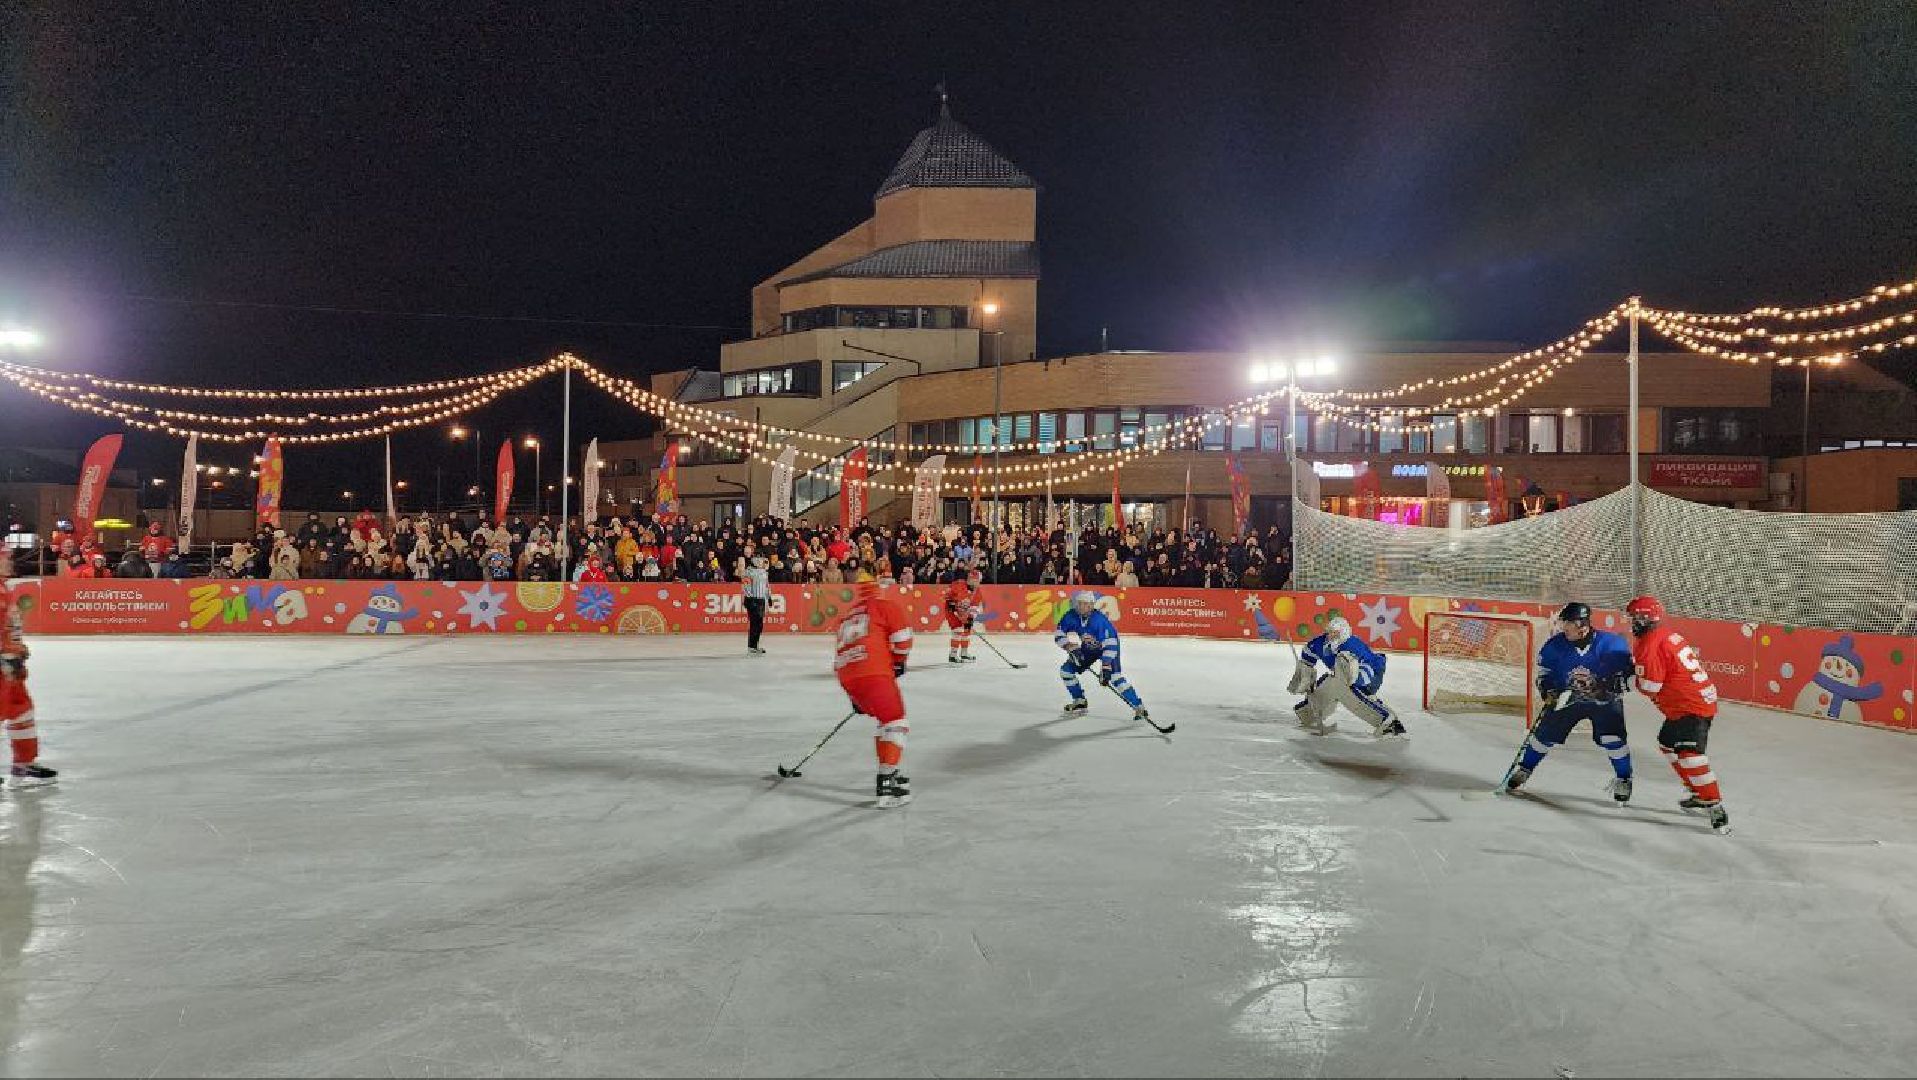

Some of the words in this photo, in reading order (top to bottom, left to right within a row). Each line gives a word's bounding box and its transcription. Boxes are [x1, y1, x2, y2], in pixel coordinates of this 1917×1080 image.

[75, 589, 143, 600] КАТАЙТЕСЬ
[50, 602, 58, 611] С
[1152, 596, 1206, 607] КАТАЙТЕСЬ
[1132, 607, 1140, 615] С
